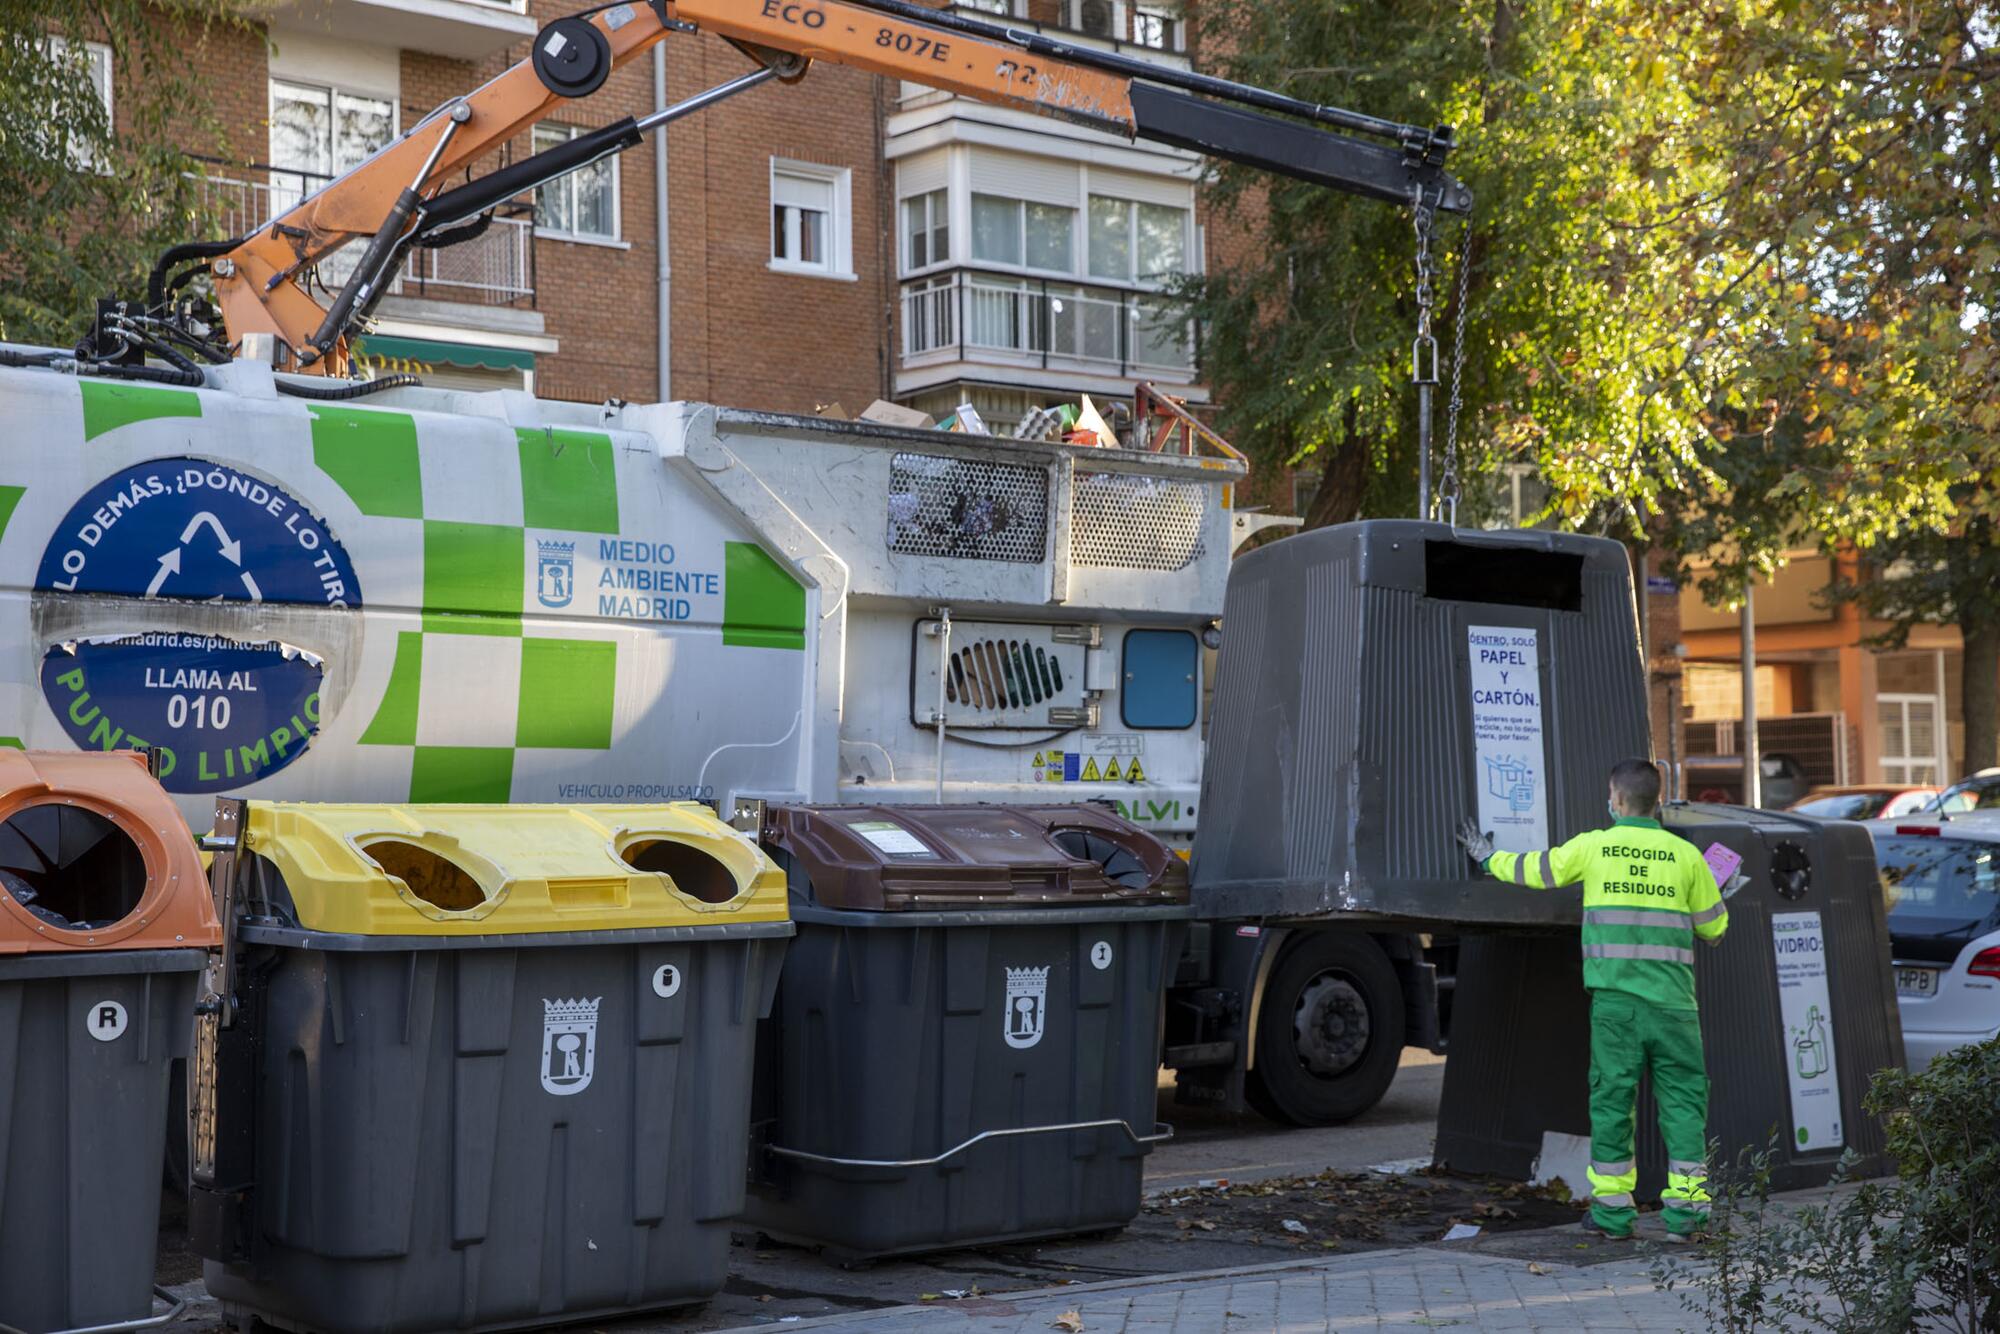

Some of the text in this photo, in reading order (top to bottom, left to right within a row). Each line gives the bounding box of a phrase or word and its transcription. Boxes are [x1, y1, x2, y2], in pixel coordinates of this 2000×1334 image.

[761, 0, 825, 29] ECO
[875, 28, 950, 62] 807E
[53, 549, 86, 592] LO
[78, 475, 172, 547] DEMÁS,
[176, 467, 287, 518] ¿DÓNDE
[284, 512, 319, 550] LO
[599, 538, 675, 565] MEDIO
[598, 566, 719, 595] AMBIENTE
[598, 594, 691, 620] MADRID
[1480, 649, 1526, 665] PAPEL
[145, 667, 257, 691] LLAMA AL
[1500, 671, 1509, 685] Y
[1473, 688, 1540, 707] CARTÓN.
[167, 694, 231, 730] 010
[559, 783, 714, 799] VEHICULO PROPULSADO
[1602, 846, 1676, 863] RECOGIDA
[1629, 864, 1649, 878] DE
[1603, 881, 1676, 898] RESIDUOS
[99, 1006, 118, 1028] R
